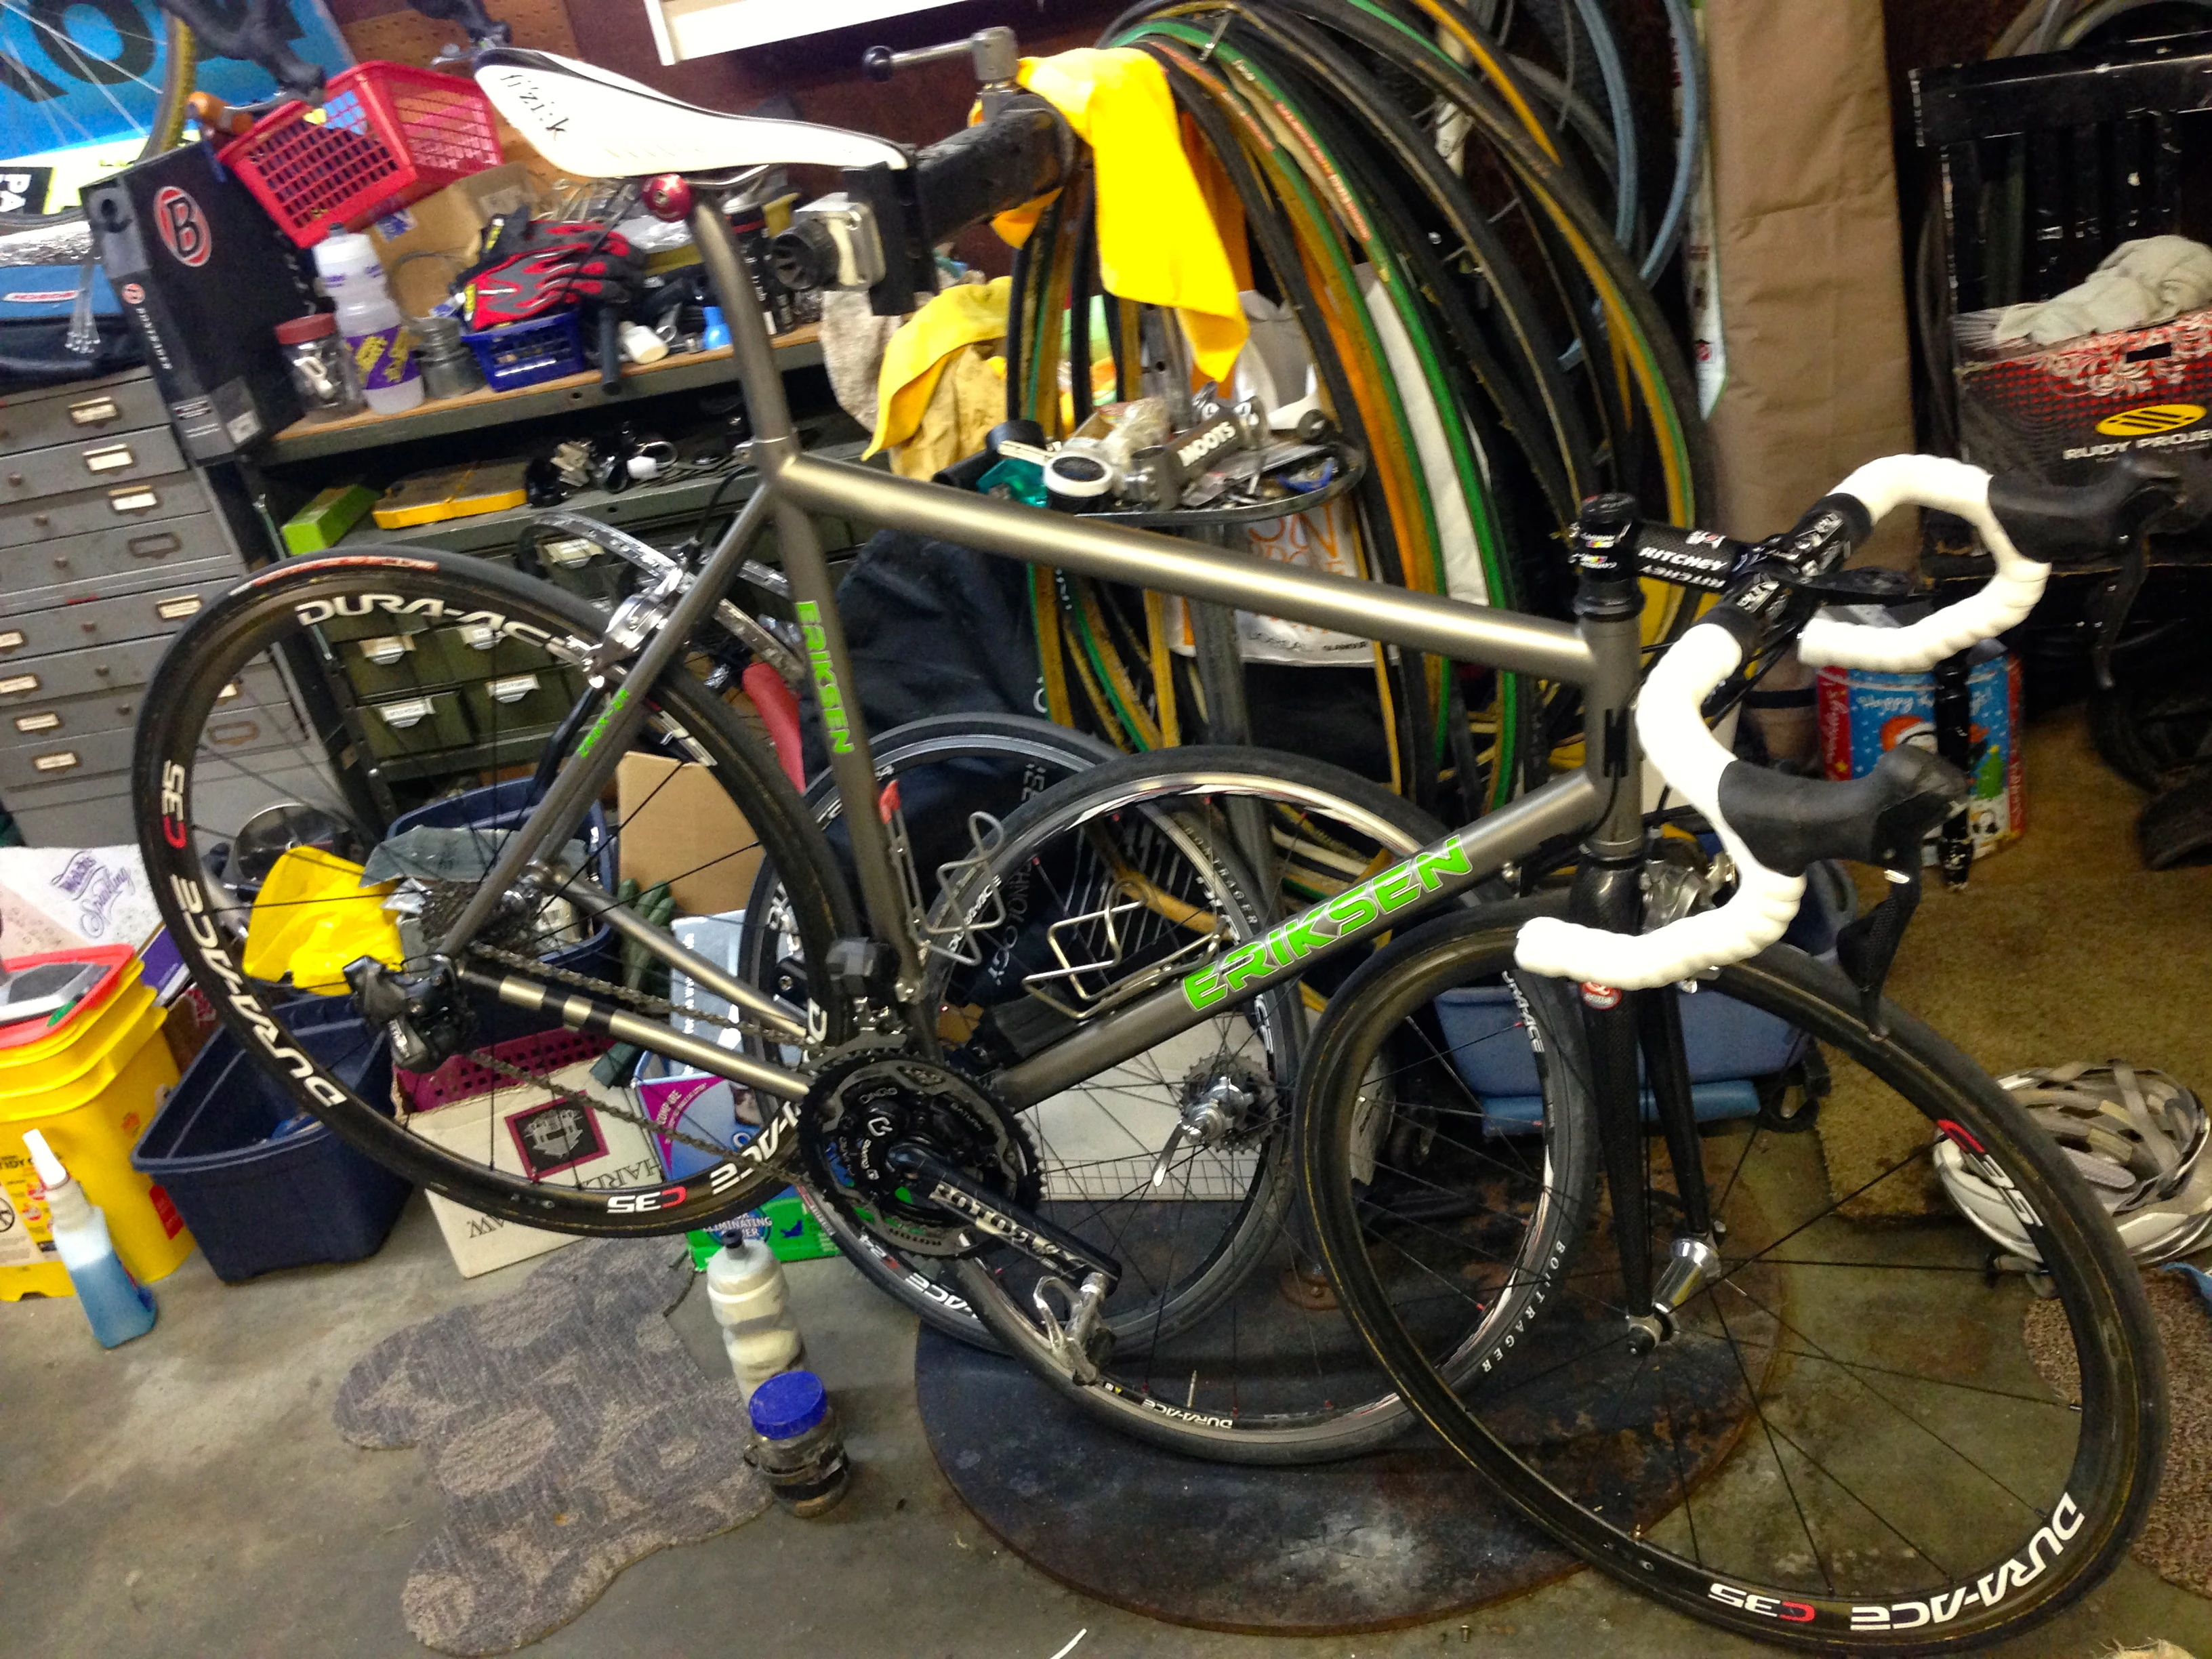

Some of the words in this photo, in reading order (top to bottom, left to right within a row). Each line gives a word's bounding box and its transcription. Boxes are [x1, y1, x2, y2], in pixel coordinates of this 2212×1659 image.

[1176, 422, 1236, 466] MOOTS
[2062, 441, 2131, 459] RUDY
[2135, 428, 2212, 449] PROJE
[1637, 547, 1728, 572] RITCHEY
[795, 600, 855, 754] ERIKSEN
[161, 760, 186, 849] C35
[1183, 834, 1473, 1012] ERIKSEN
[169, 874, 348, 1108] DURA-ACE
[1500, 970, 1545, 1053] URA-ACE
[607, 1185, 687, 1214] C35
[1481, 1240, 1566, 1373] BONTRAGER
[1140, 1397, 1233, 1430] DURA-ACE
[1707, 1582, 1816, 1624] C35
[1849, 1492, 2085, 1631] DURA-ACE
